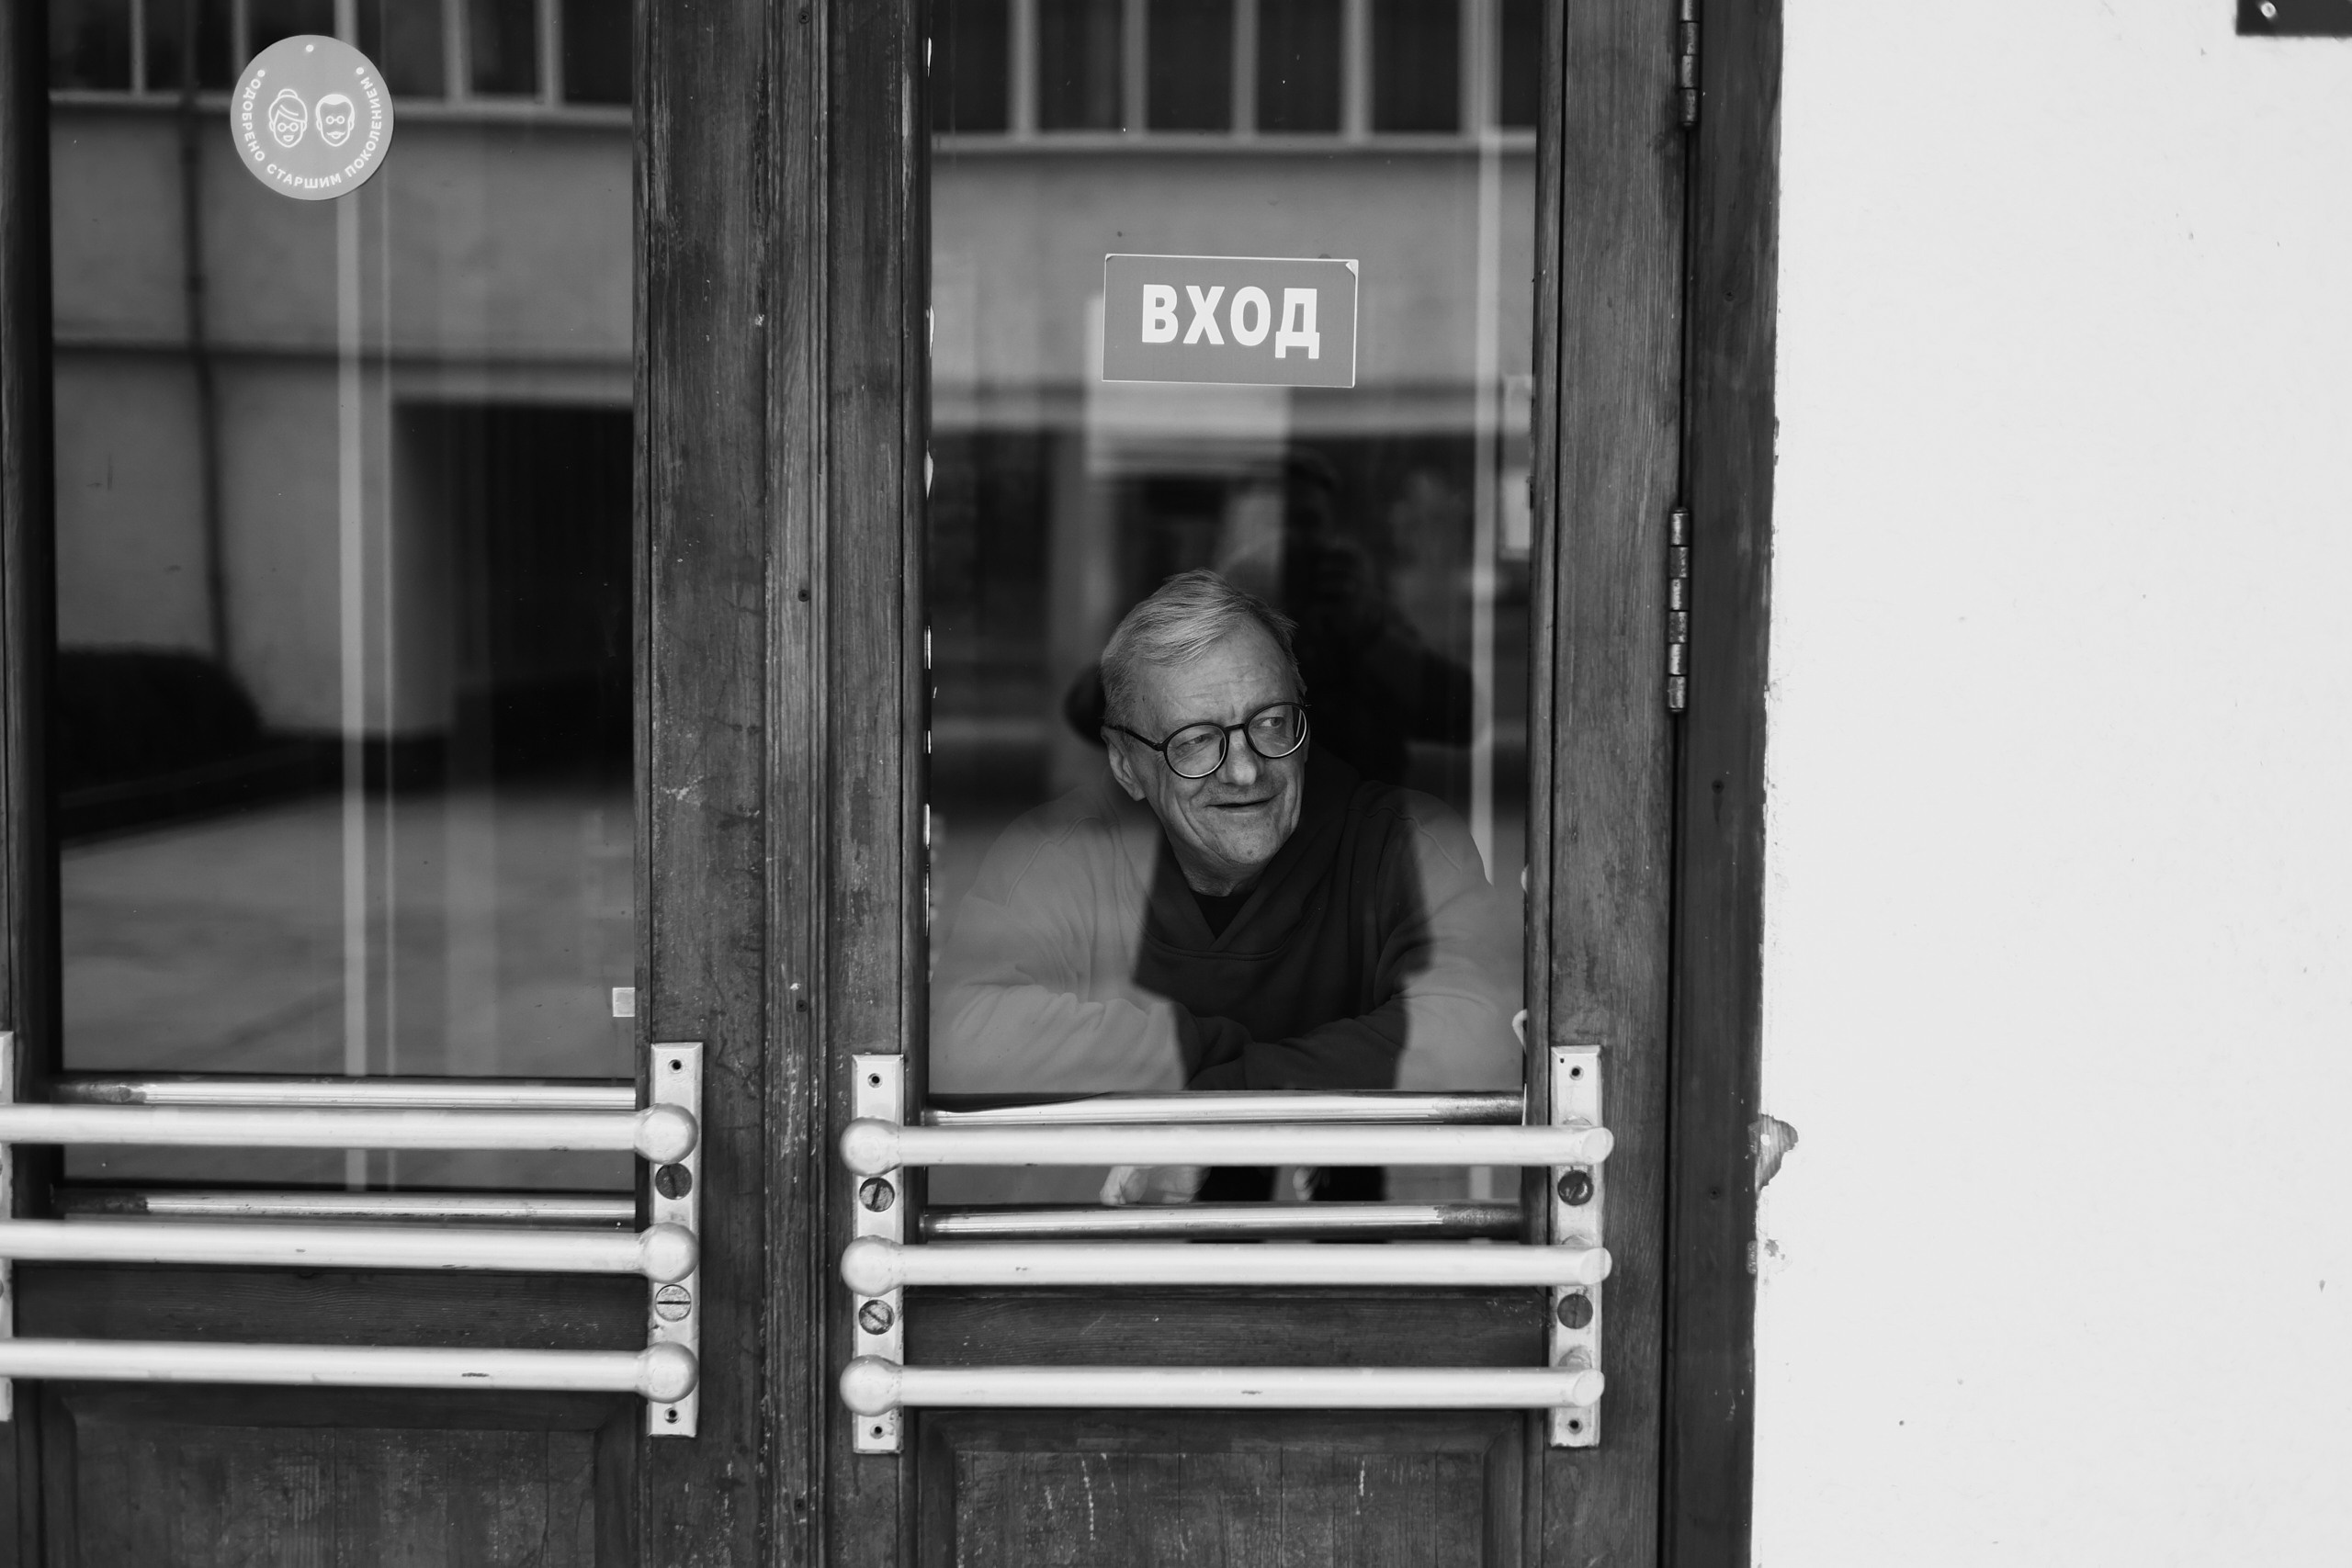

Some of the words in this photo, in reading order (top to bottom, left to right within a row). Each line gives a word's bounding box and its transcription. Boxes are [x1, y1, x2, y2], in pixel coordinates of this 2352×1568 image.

[242, 79, 266, 162] ОДОБРЕНО
[266, 164, 342, 189] СТАРШИМ
[345, 76, 382, 177] ПОКОЛЕНИЕМ
[1142, 284, 1320, 359] ВХОД
